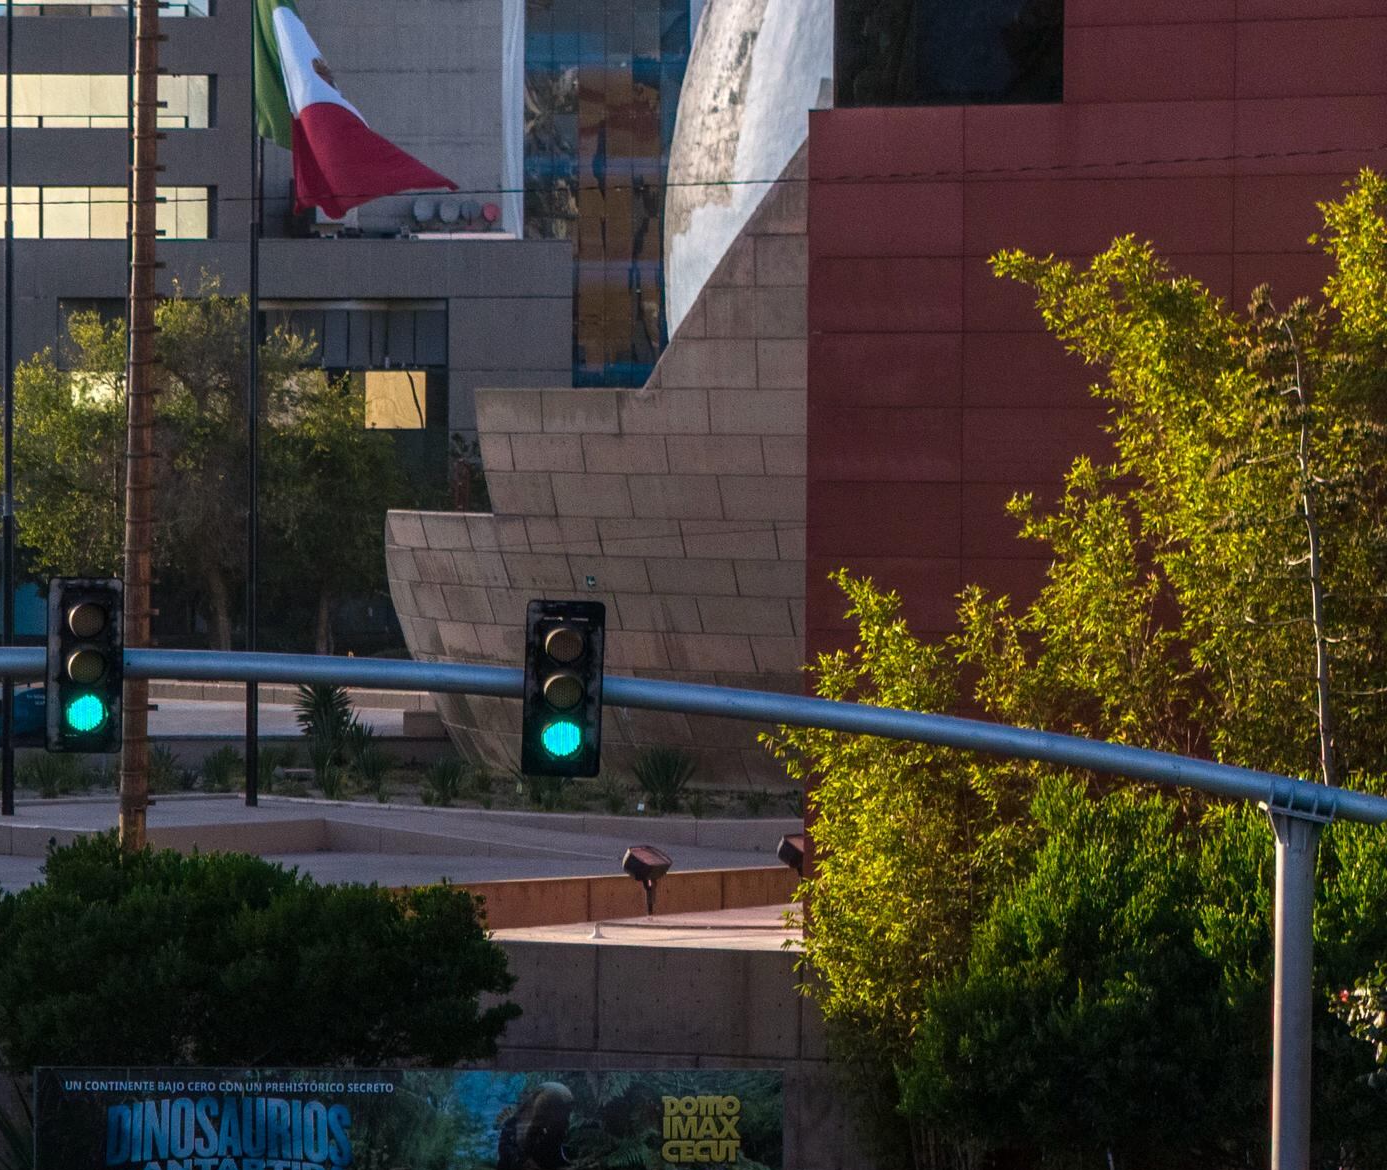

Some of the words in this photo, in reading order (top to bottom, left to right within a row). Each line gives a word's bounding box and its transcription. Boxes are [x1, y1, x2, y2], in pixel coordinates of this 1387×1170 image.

[65, 1081, 82, 1091] UN
[84, 1081, 155, 1091] CONTINENTE
[158, 1081, 185, 1094] BAJO
[187, 1082, 216, 1092] CERO
[218, 1082, 243, 1092] CON
[246, 1082, 262, 1092] UN
[265, 1080, 345, 1093] PREHISTÓRICO
[347, 1082, 394, 1093] SECRETO
[661, 1095, 741, 1116] DOMO
[105, 1096, 353, 1167] DINOSAURIOS
[662, 1116, 741, 1139] IMAX
[661, 1140, 741, 1162] CECUT
